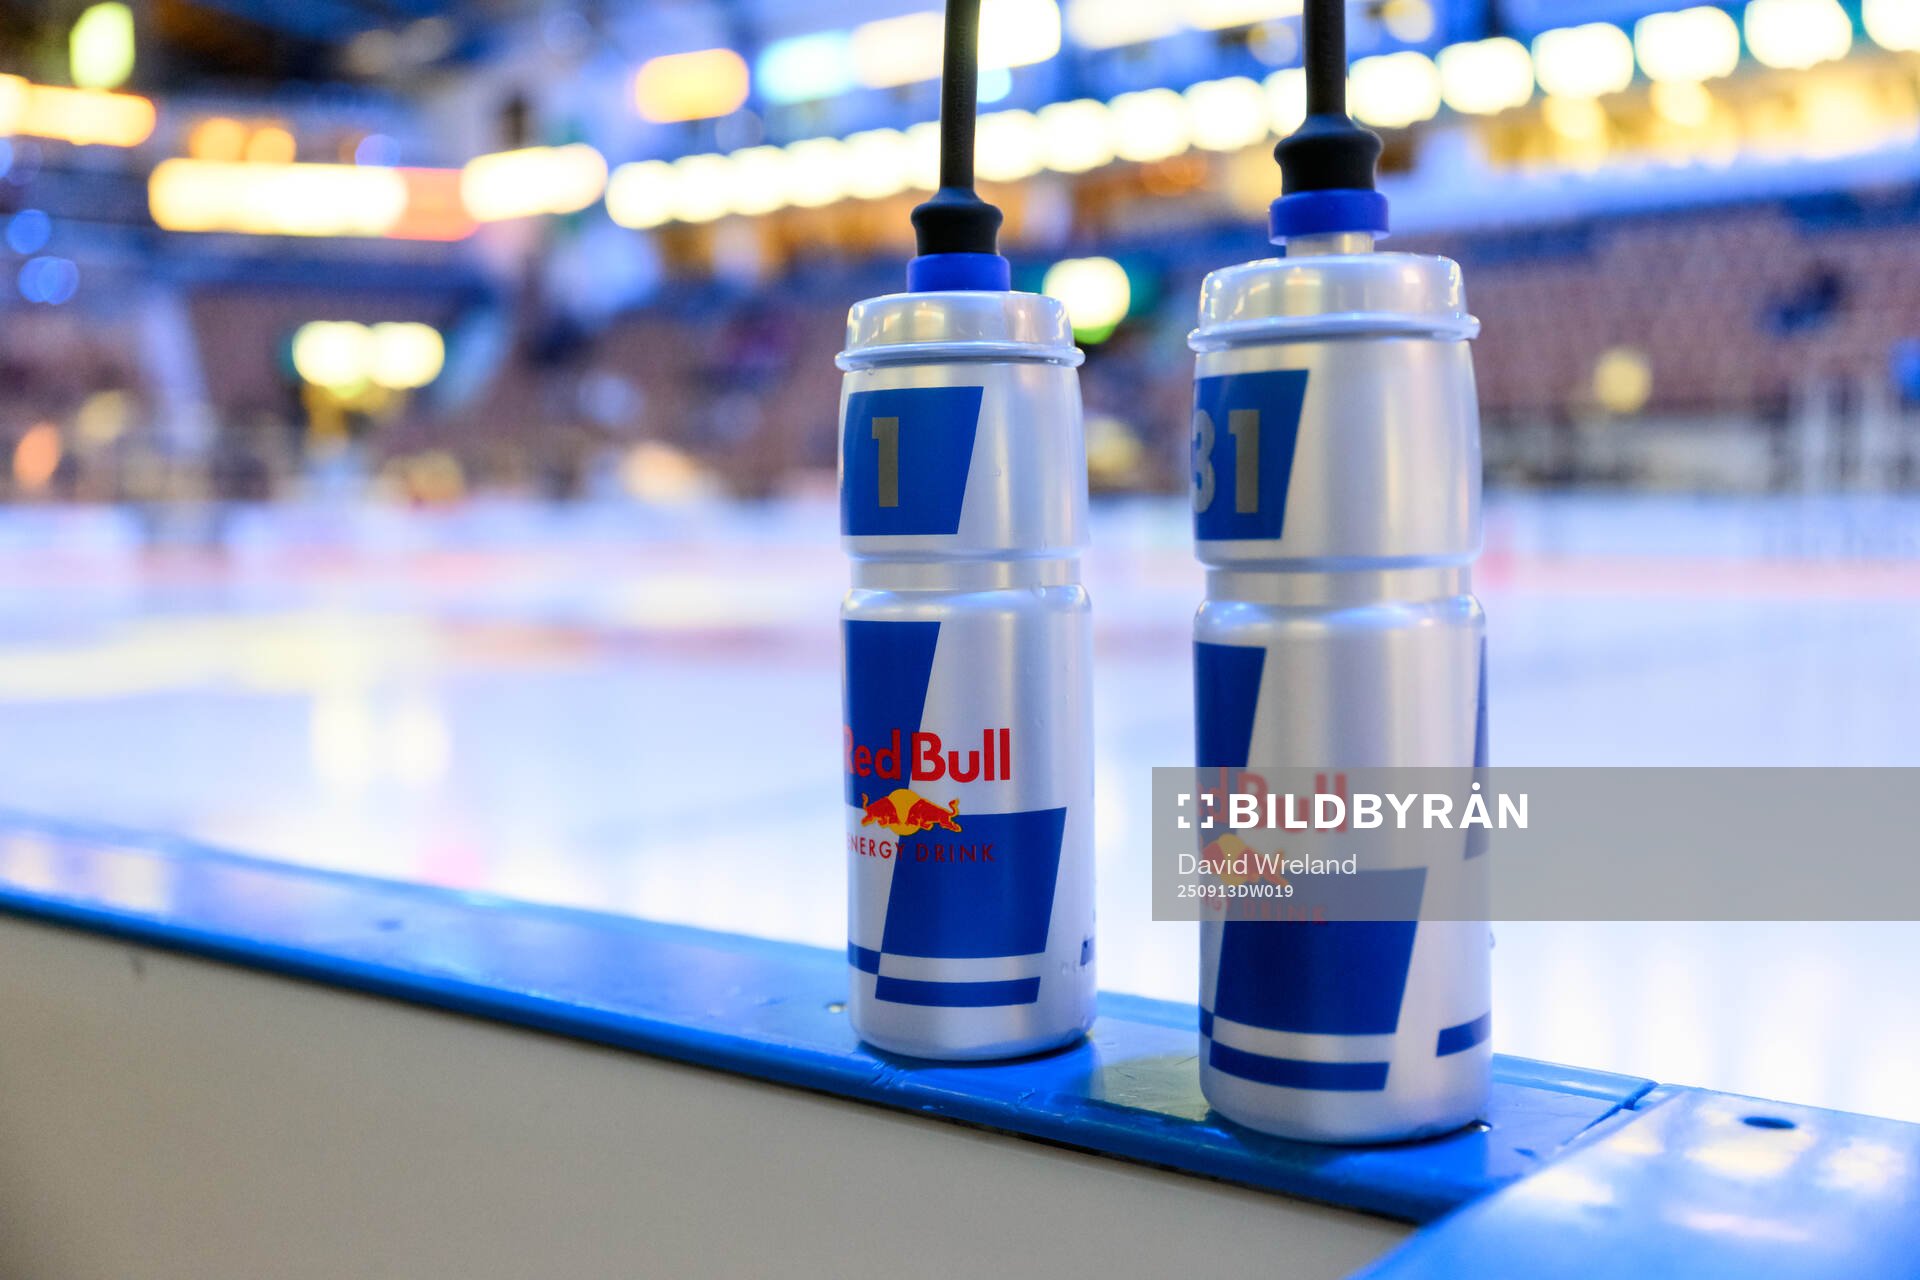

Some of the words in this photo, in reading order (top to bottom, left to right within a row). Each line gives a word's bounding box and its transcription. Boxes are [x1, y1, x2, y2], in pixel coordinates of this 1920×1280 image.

[1191, 409, 1260, 513] 31
[911, 728, 1010, 783] Bull
[847, 832, 905, 860] NERGY
[915, 843, 996, 863] DRINK
